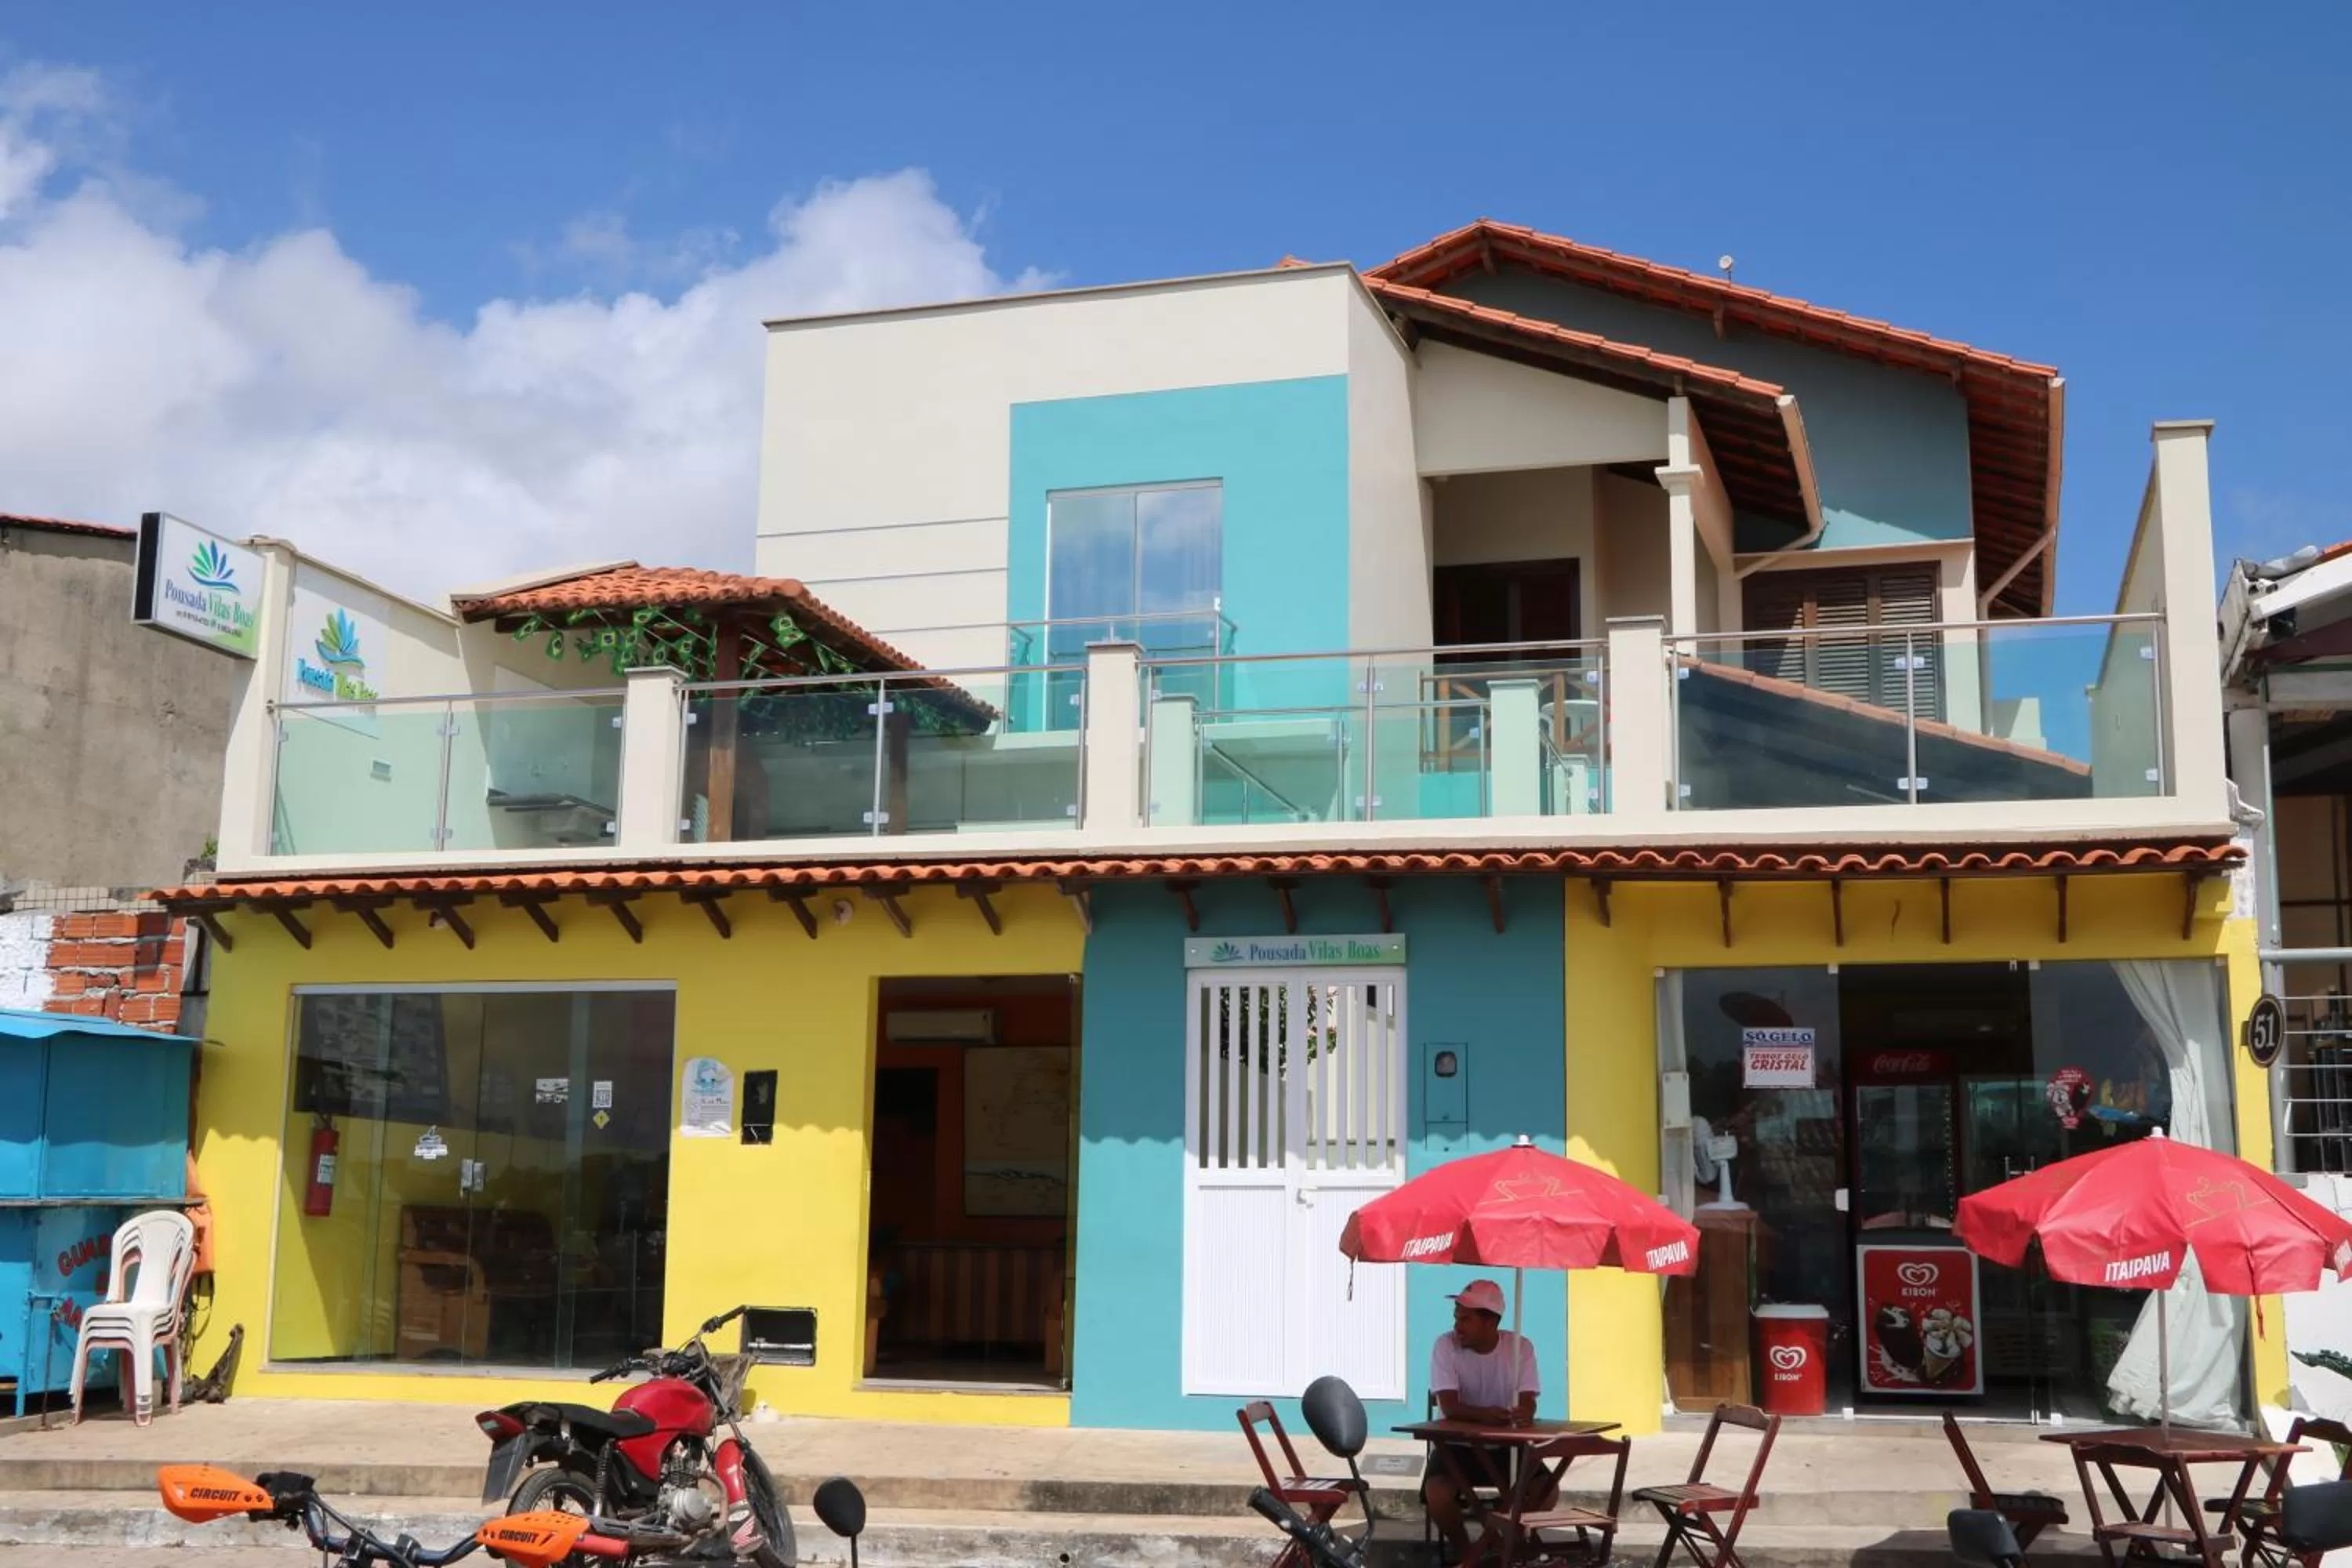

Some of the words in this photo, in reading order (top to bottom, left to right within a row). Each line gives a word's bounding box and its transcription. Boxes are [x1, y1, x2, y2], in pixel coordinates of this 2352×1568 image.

[165, 577, 207, 612] Pousada
[1249, 943, 1306, 960] Pousada
[1308, 940, 1343, 960] Vilas
[1348, 940, 1381, 960] Boas
[1769, 1031, 1812, 1042] GELO
[2254, 1013, 2275, 1049] 51
[1751, 1059, 1807, 1070] CRISTAL
[1402, 1232, 1454, 1258] ITAIPAVA
[1646, 1240, 1689, 1270] ITAIPAVA
[2104, 1250, 2170, 1283] ITAIPAVA
[1901, 1287, 1936, 1298] KIBON
[190, 1486, 241, 1502] CIRCUIT
[498, 1530, 540, 1544] CIRCUIT
